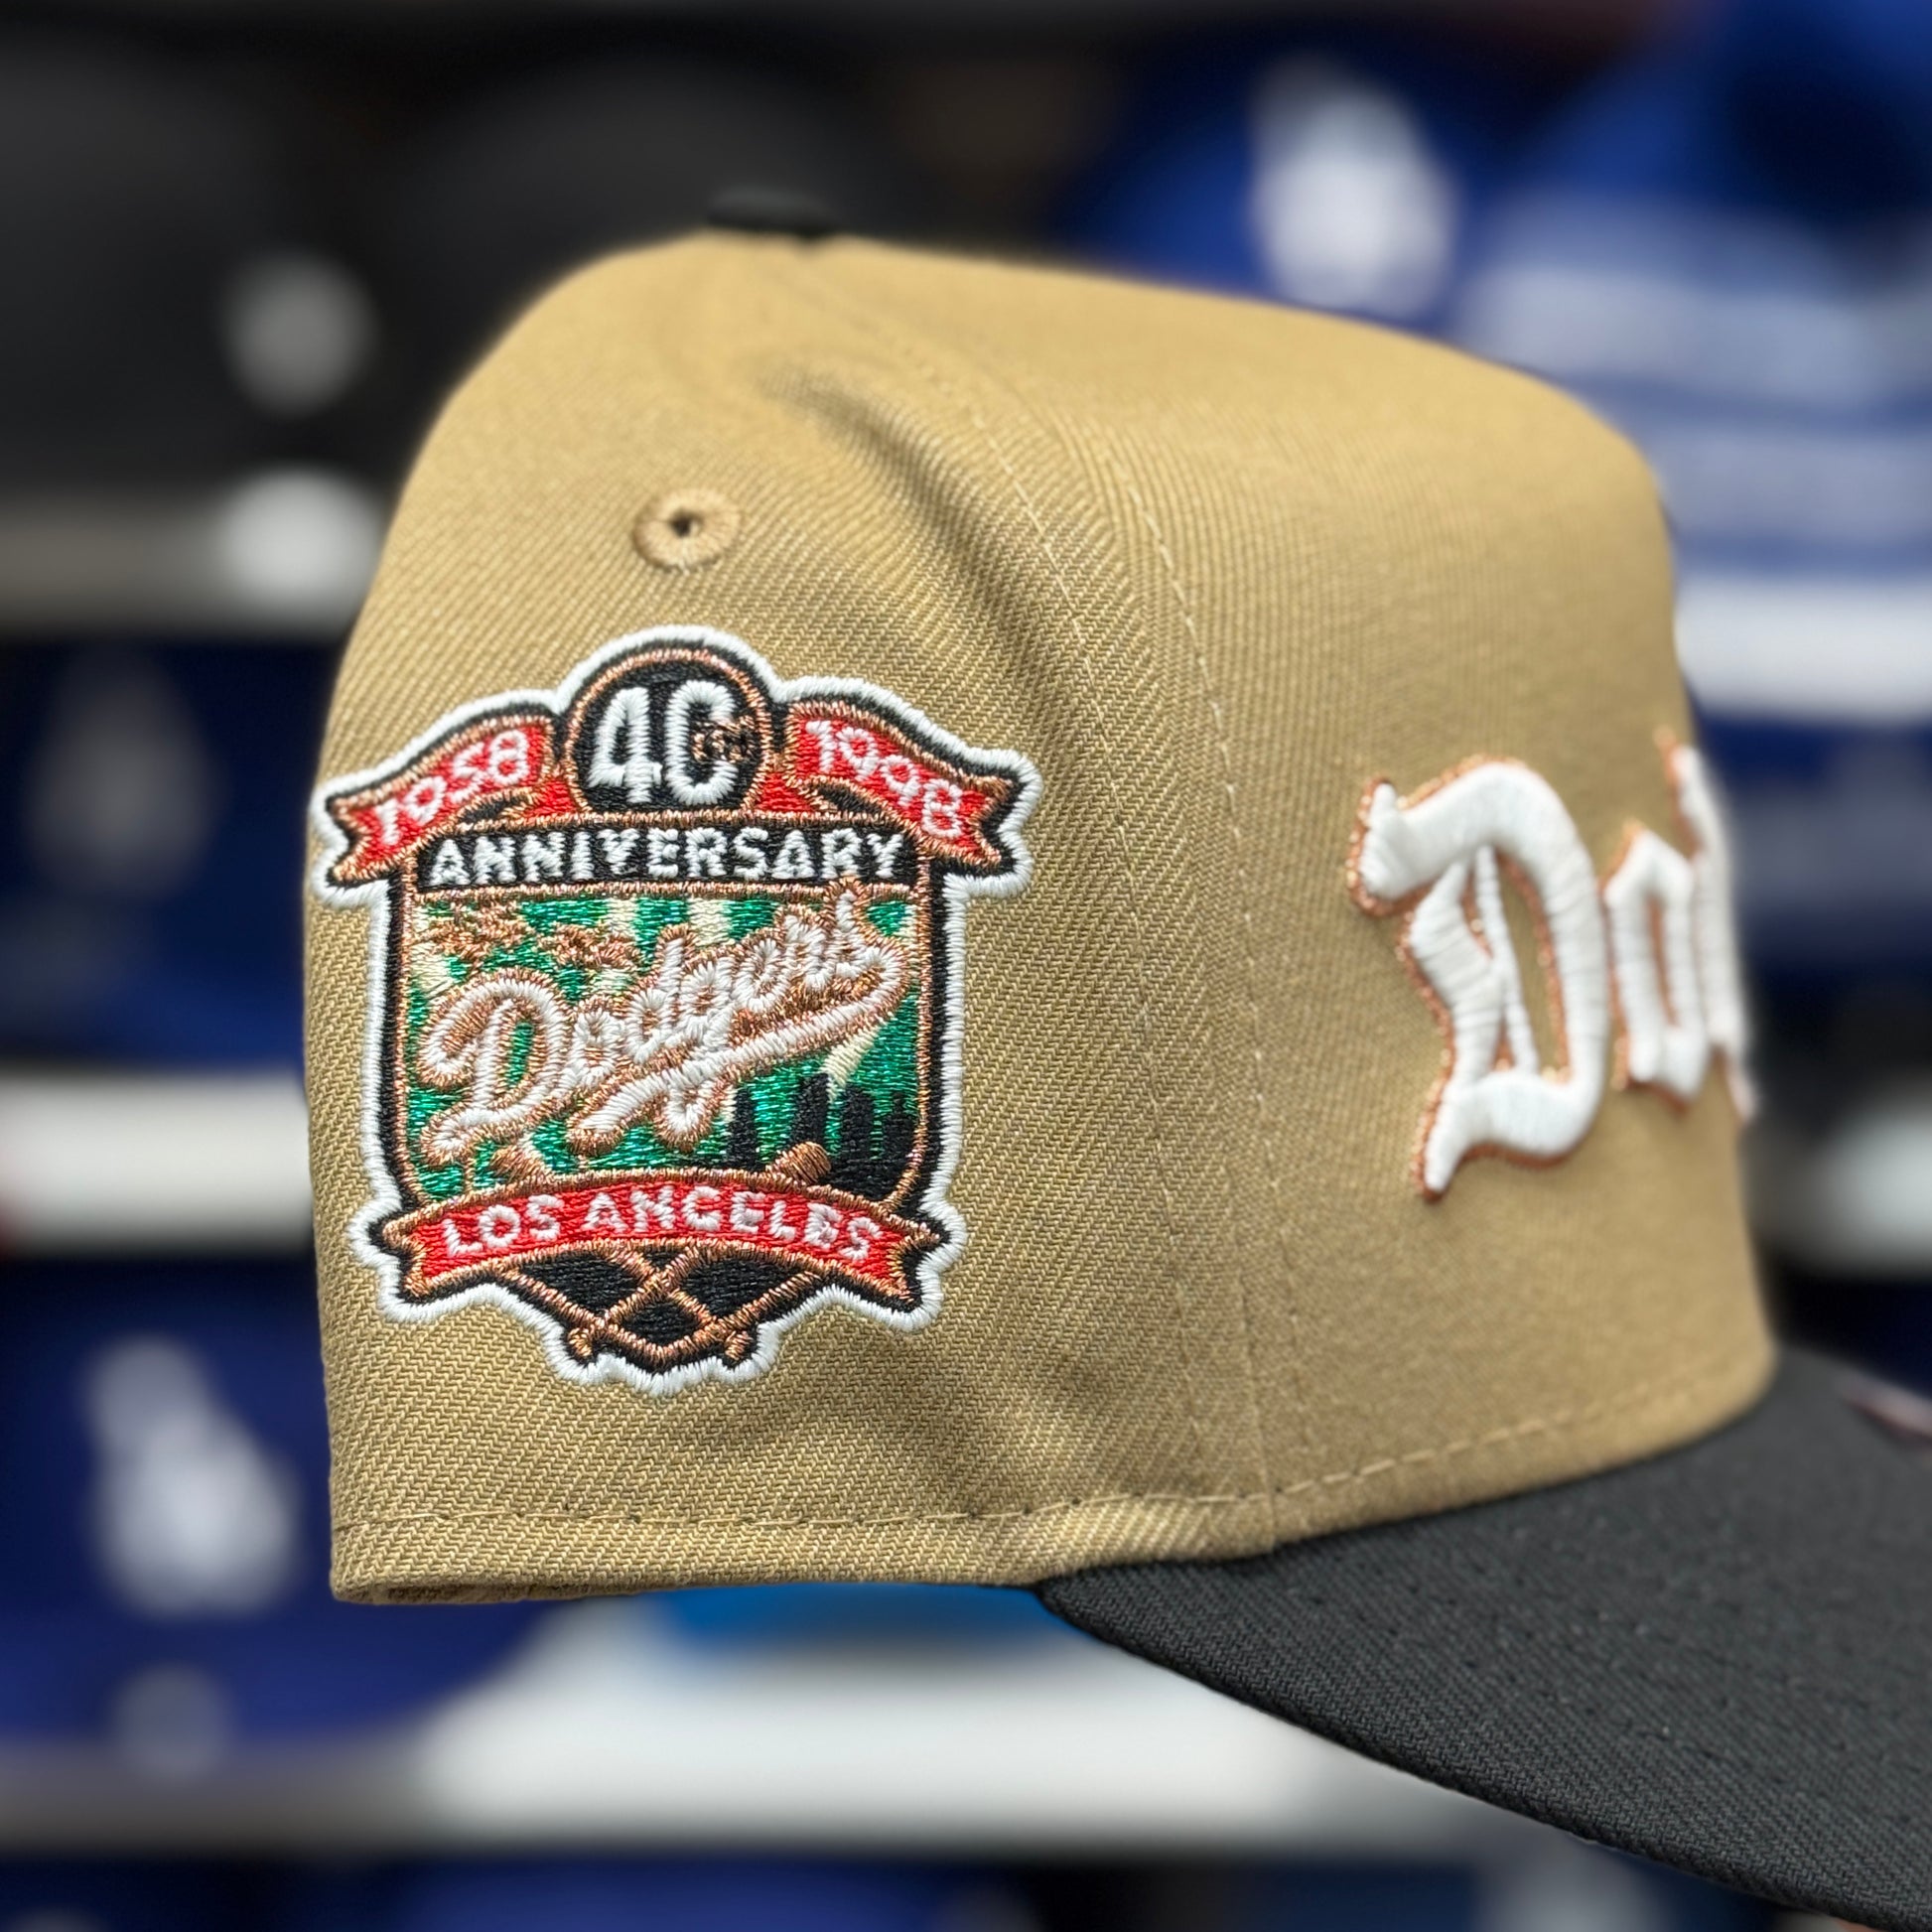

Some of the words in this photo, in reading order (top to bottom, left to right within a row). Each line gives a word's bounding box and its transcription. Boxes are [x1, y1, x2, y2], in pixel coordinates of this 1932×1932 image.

[374, 730, 530, 847] 1958
[804, 719, 963, 840] 1998
[429, 826, 904, 887] ANNIVERSARY
[420, 880, 907, 1165] Dodgers
[441, 1193, 566, 1259] LOS
[582, 1183, 886, 1262] ANGELES
